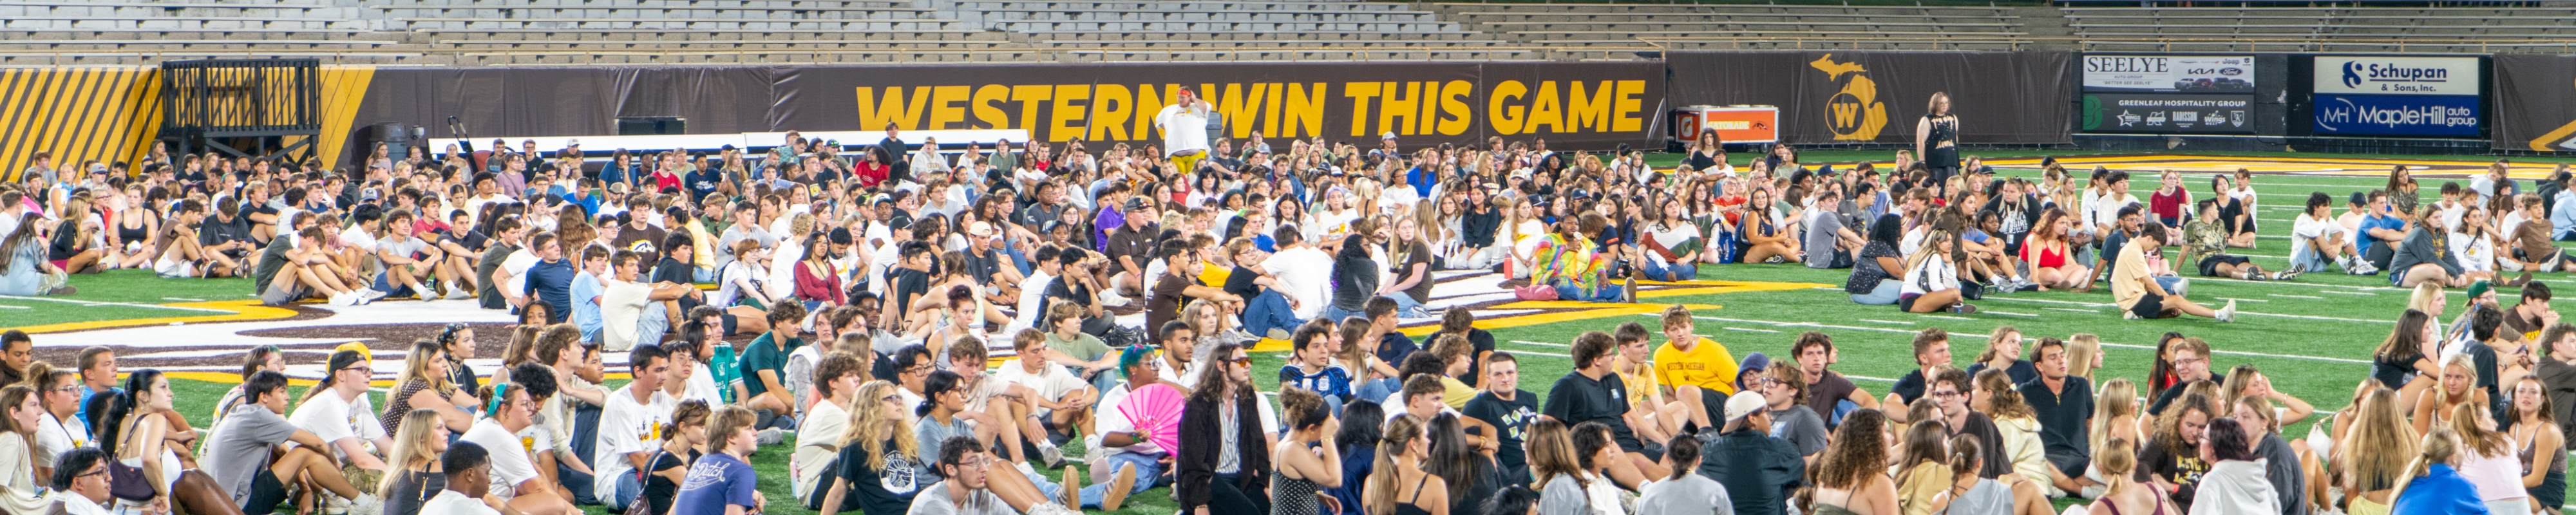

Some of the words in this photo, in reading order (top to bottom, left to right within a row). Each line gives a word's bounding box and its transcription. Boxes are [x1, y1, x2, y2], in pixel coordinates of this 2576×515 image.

[2087, 57, 2168, 73] SEELYE
[2369, 63, 2447, 82] Schupan
[2394, 84, 2418, 93] Sons,
[856, 84, 1180, 142] WESTERN
[1200, 82, 1327, 138] WIN
[1345, 81, 1472, 136] THIS
[1488, 80, 1645, 135] GAME
[1833, 103, 1859, 128] W
[2172, 111, 2197, 122] RADISSON
[2447, 107, 2470, 117] auto
[1707, 121, 1750, 129] GATORADE
[2447, 117, 2477, 127] group
